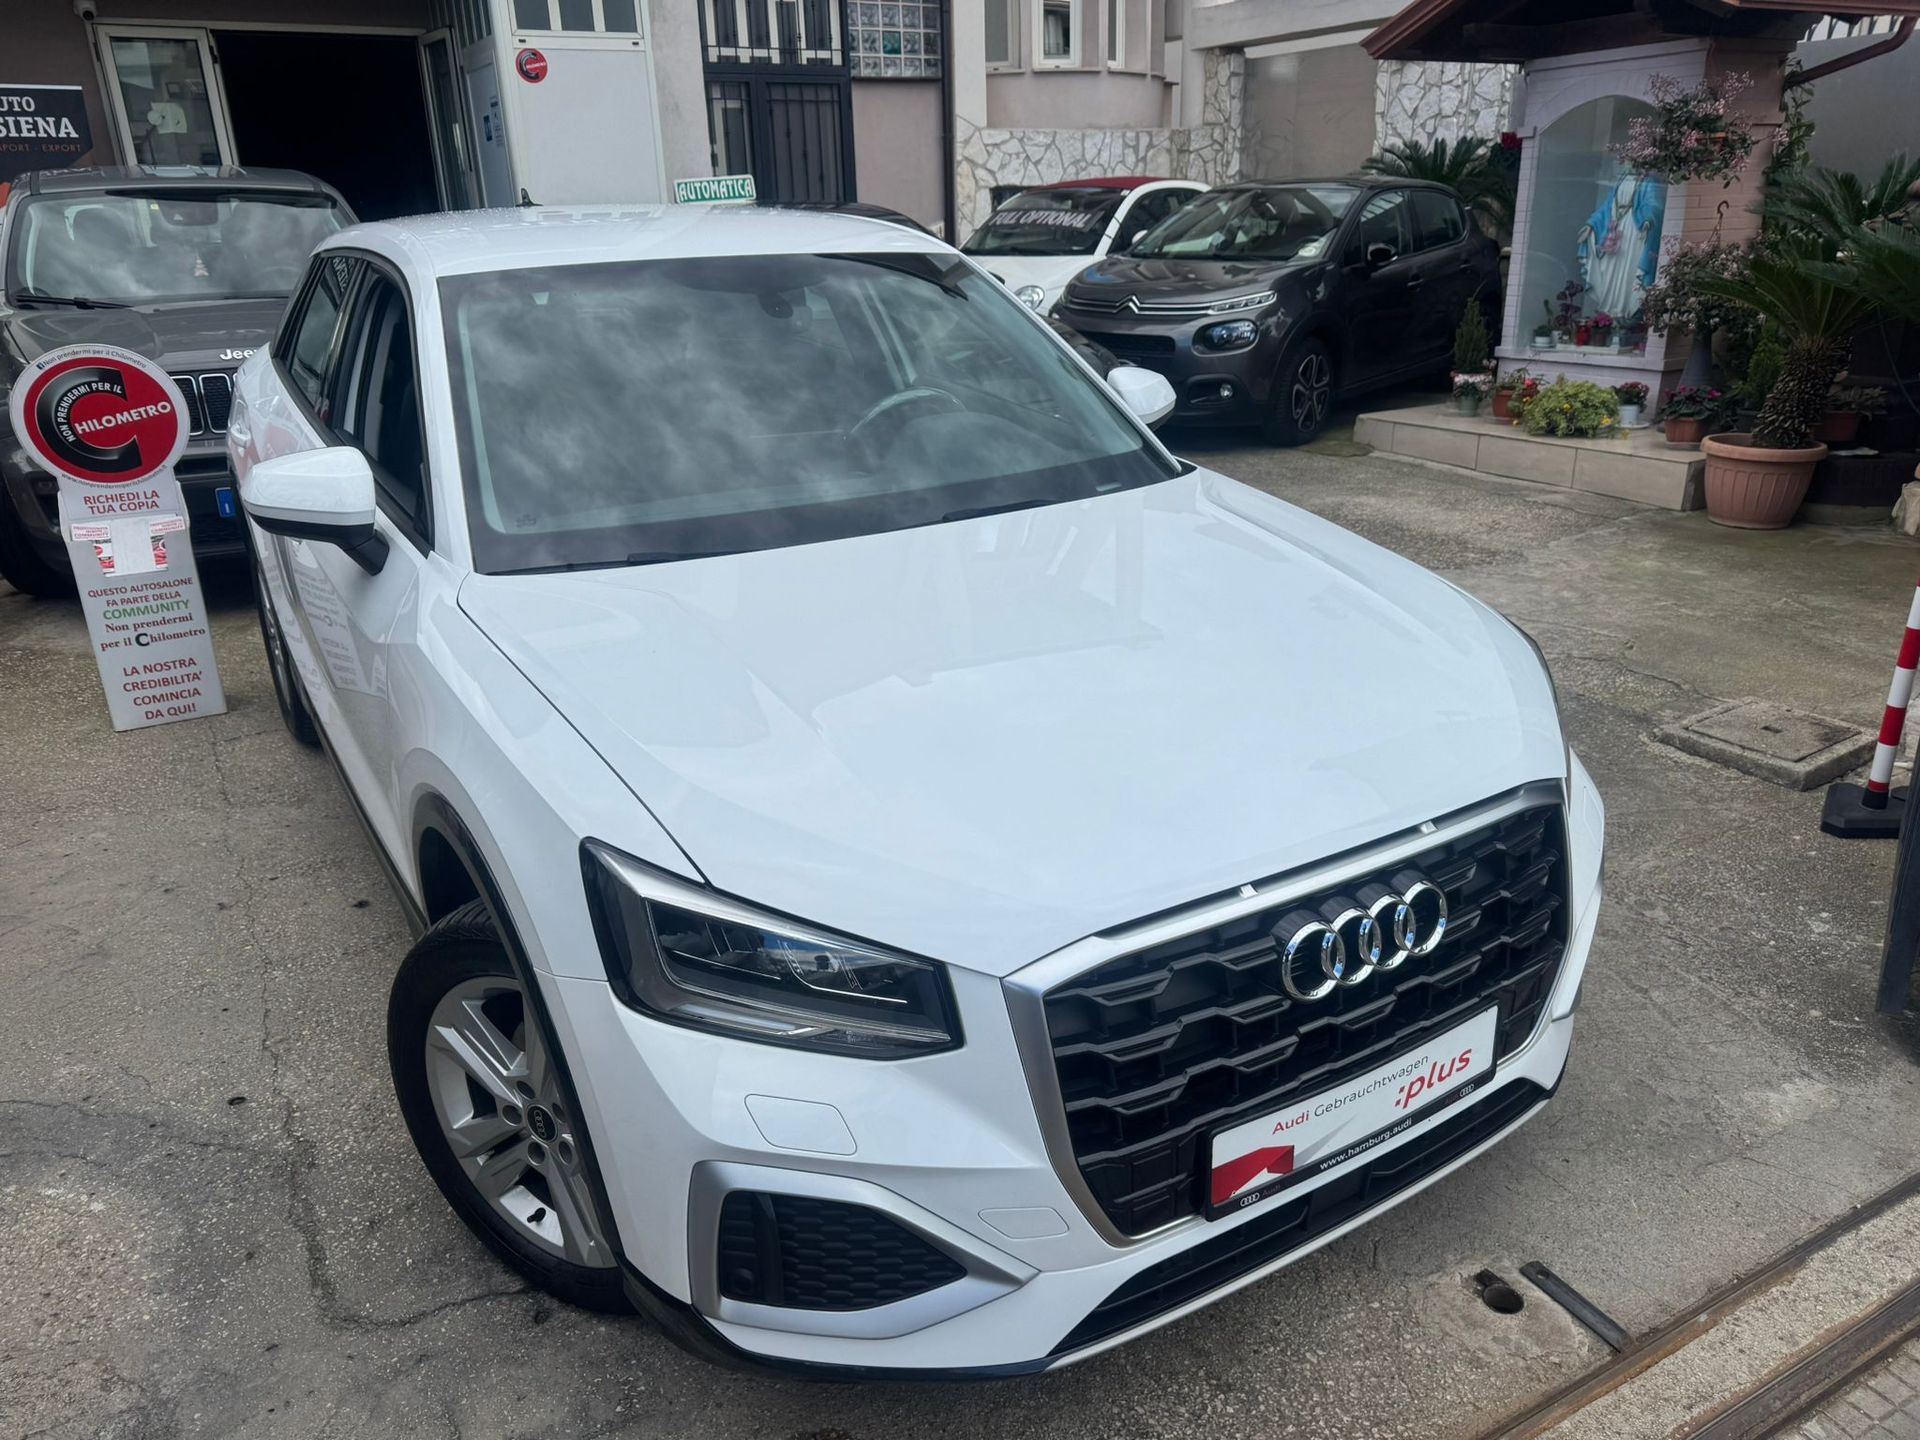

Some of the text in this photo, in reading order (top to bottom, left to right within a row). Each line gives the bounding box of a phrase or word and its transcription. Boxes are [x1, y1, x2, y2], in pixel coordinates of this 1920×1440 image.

[0, 143, 81, 152] PORT EXPORT
[679, 178, 753, 201] AUTOMATICA
[988, 210, 1092, 228] FULL OPTIONAL
[56, 349, 91, 361] prendermi
[92, 349, 105, 357] per
[111, 350, 147, 369] Chilometro
[220, 348, 257, 360] Jee
[57, 382, 123, 443] NON PRENDERMI PER IL
[83, 489, 160, 505] RICHIEDI LA
[88, 500, 160, 515] TUA COPIA
[87, 577, 193, 598] QUESTO AUTOSALONE
[106, 591, 181, 607] FA PARTE DELLA
[103, 600, 190, 620] COMMUNITY
[105, 612, 194, 633] Non prendermi
[100, 628, 206, 652] per il Chilometro
[123, 657, 197, 677] LA NOSTRA
[123, 671, 202, 692] CREDIBILITA'
[133, 687, 202, 706] COMINCIA
[144, 702, 197, 720] DA QUI!
[1272, 1054, 1429, 1136] Audi Gebrauchtwagen
[1319, 1117, 1413, 1171] www.hamburg.audi
